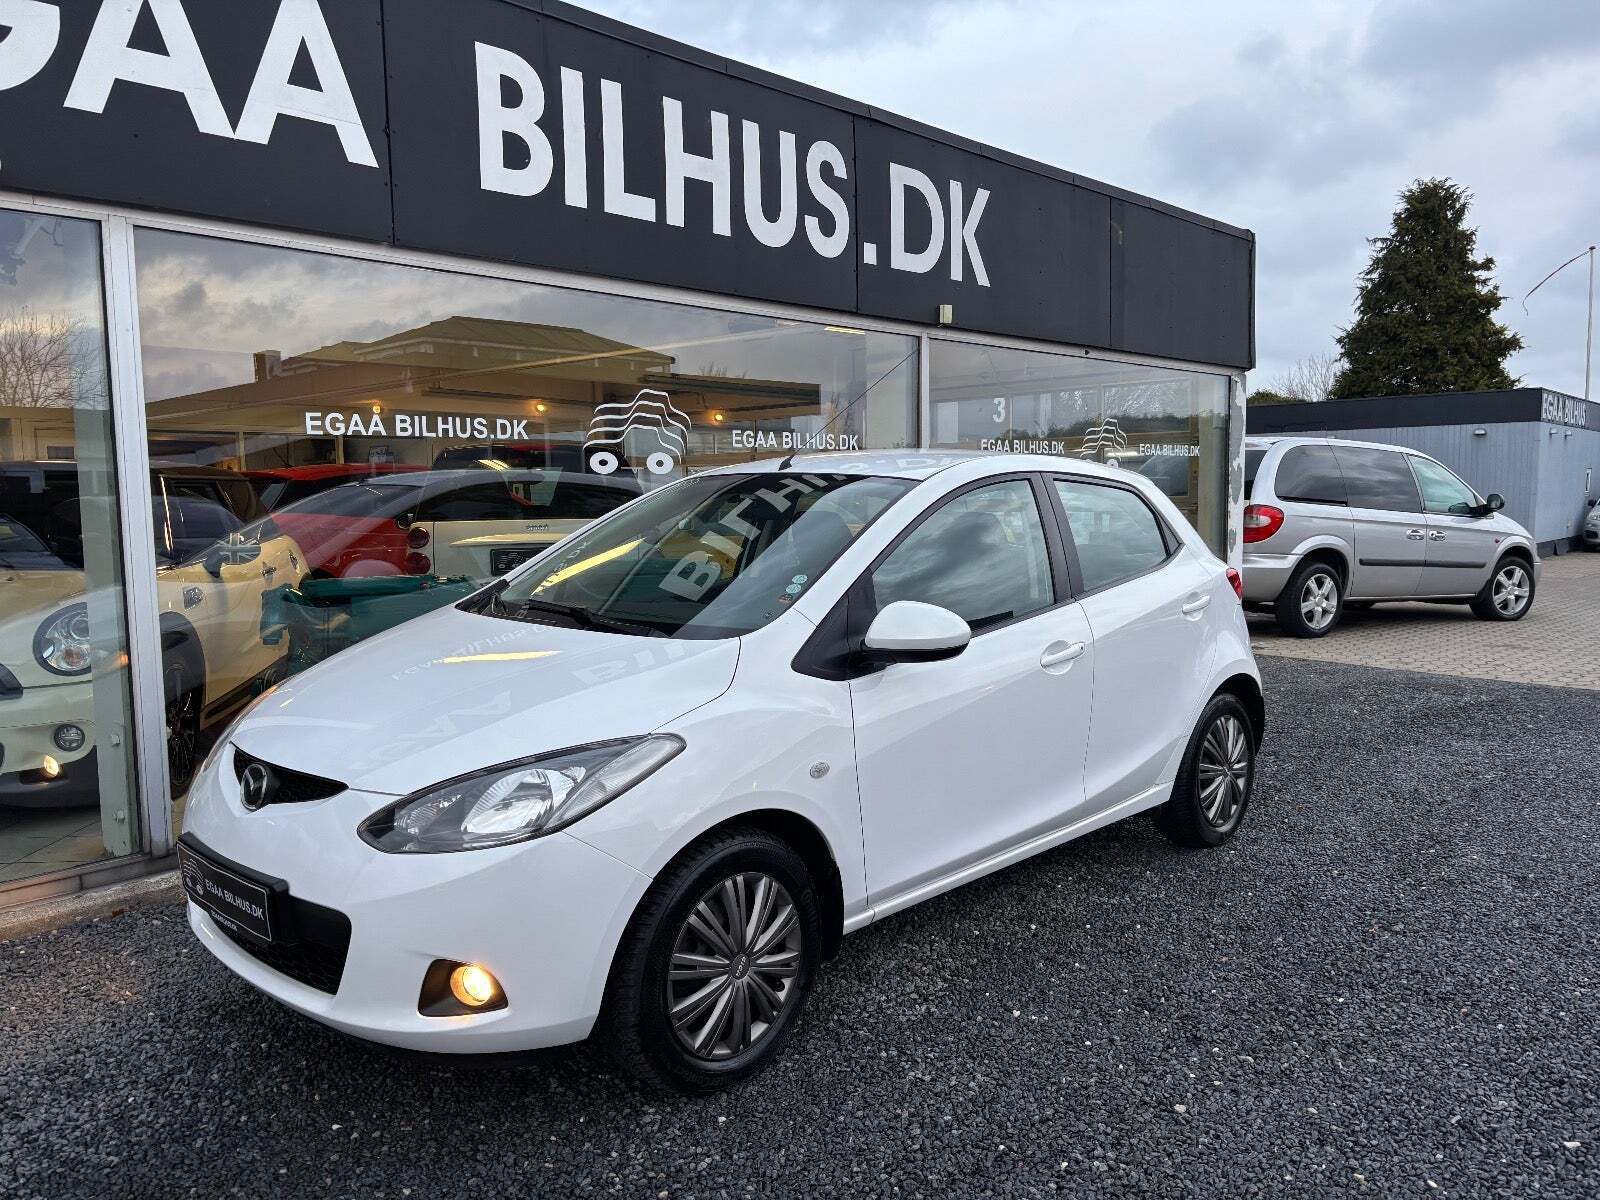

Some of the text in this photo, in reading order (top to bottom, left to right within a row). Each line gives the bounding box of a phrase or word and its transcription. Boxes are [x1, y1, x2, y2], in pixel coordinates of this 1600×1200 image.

[474, 41, 991, 288] BILHUS.DK
[394, 414, 529, 440] BILHUS.DK
[732, 430, 860, 451] EGAA BILHUS.DK
[1013, 440, 1065, 455] BILHUS.DK
[1139, 443, 1163, 457] EGAA
[205, 879, 225, 901] EGAA
[223, 888, 265, 921] BILHUS.DK
